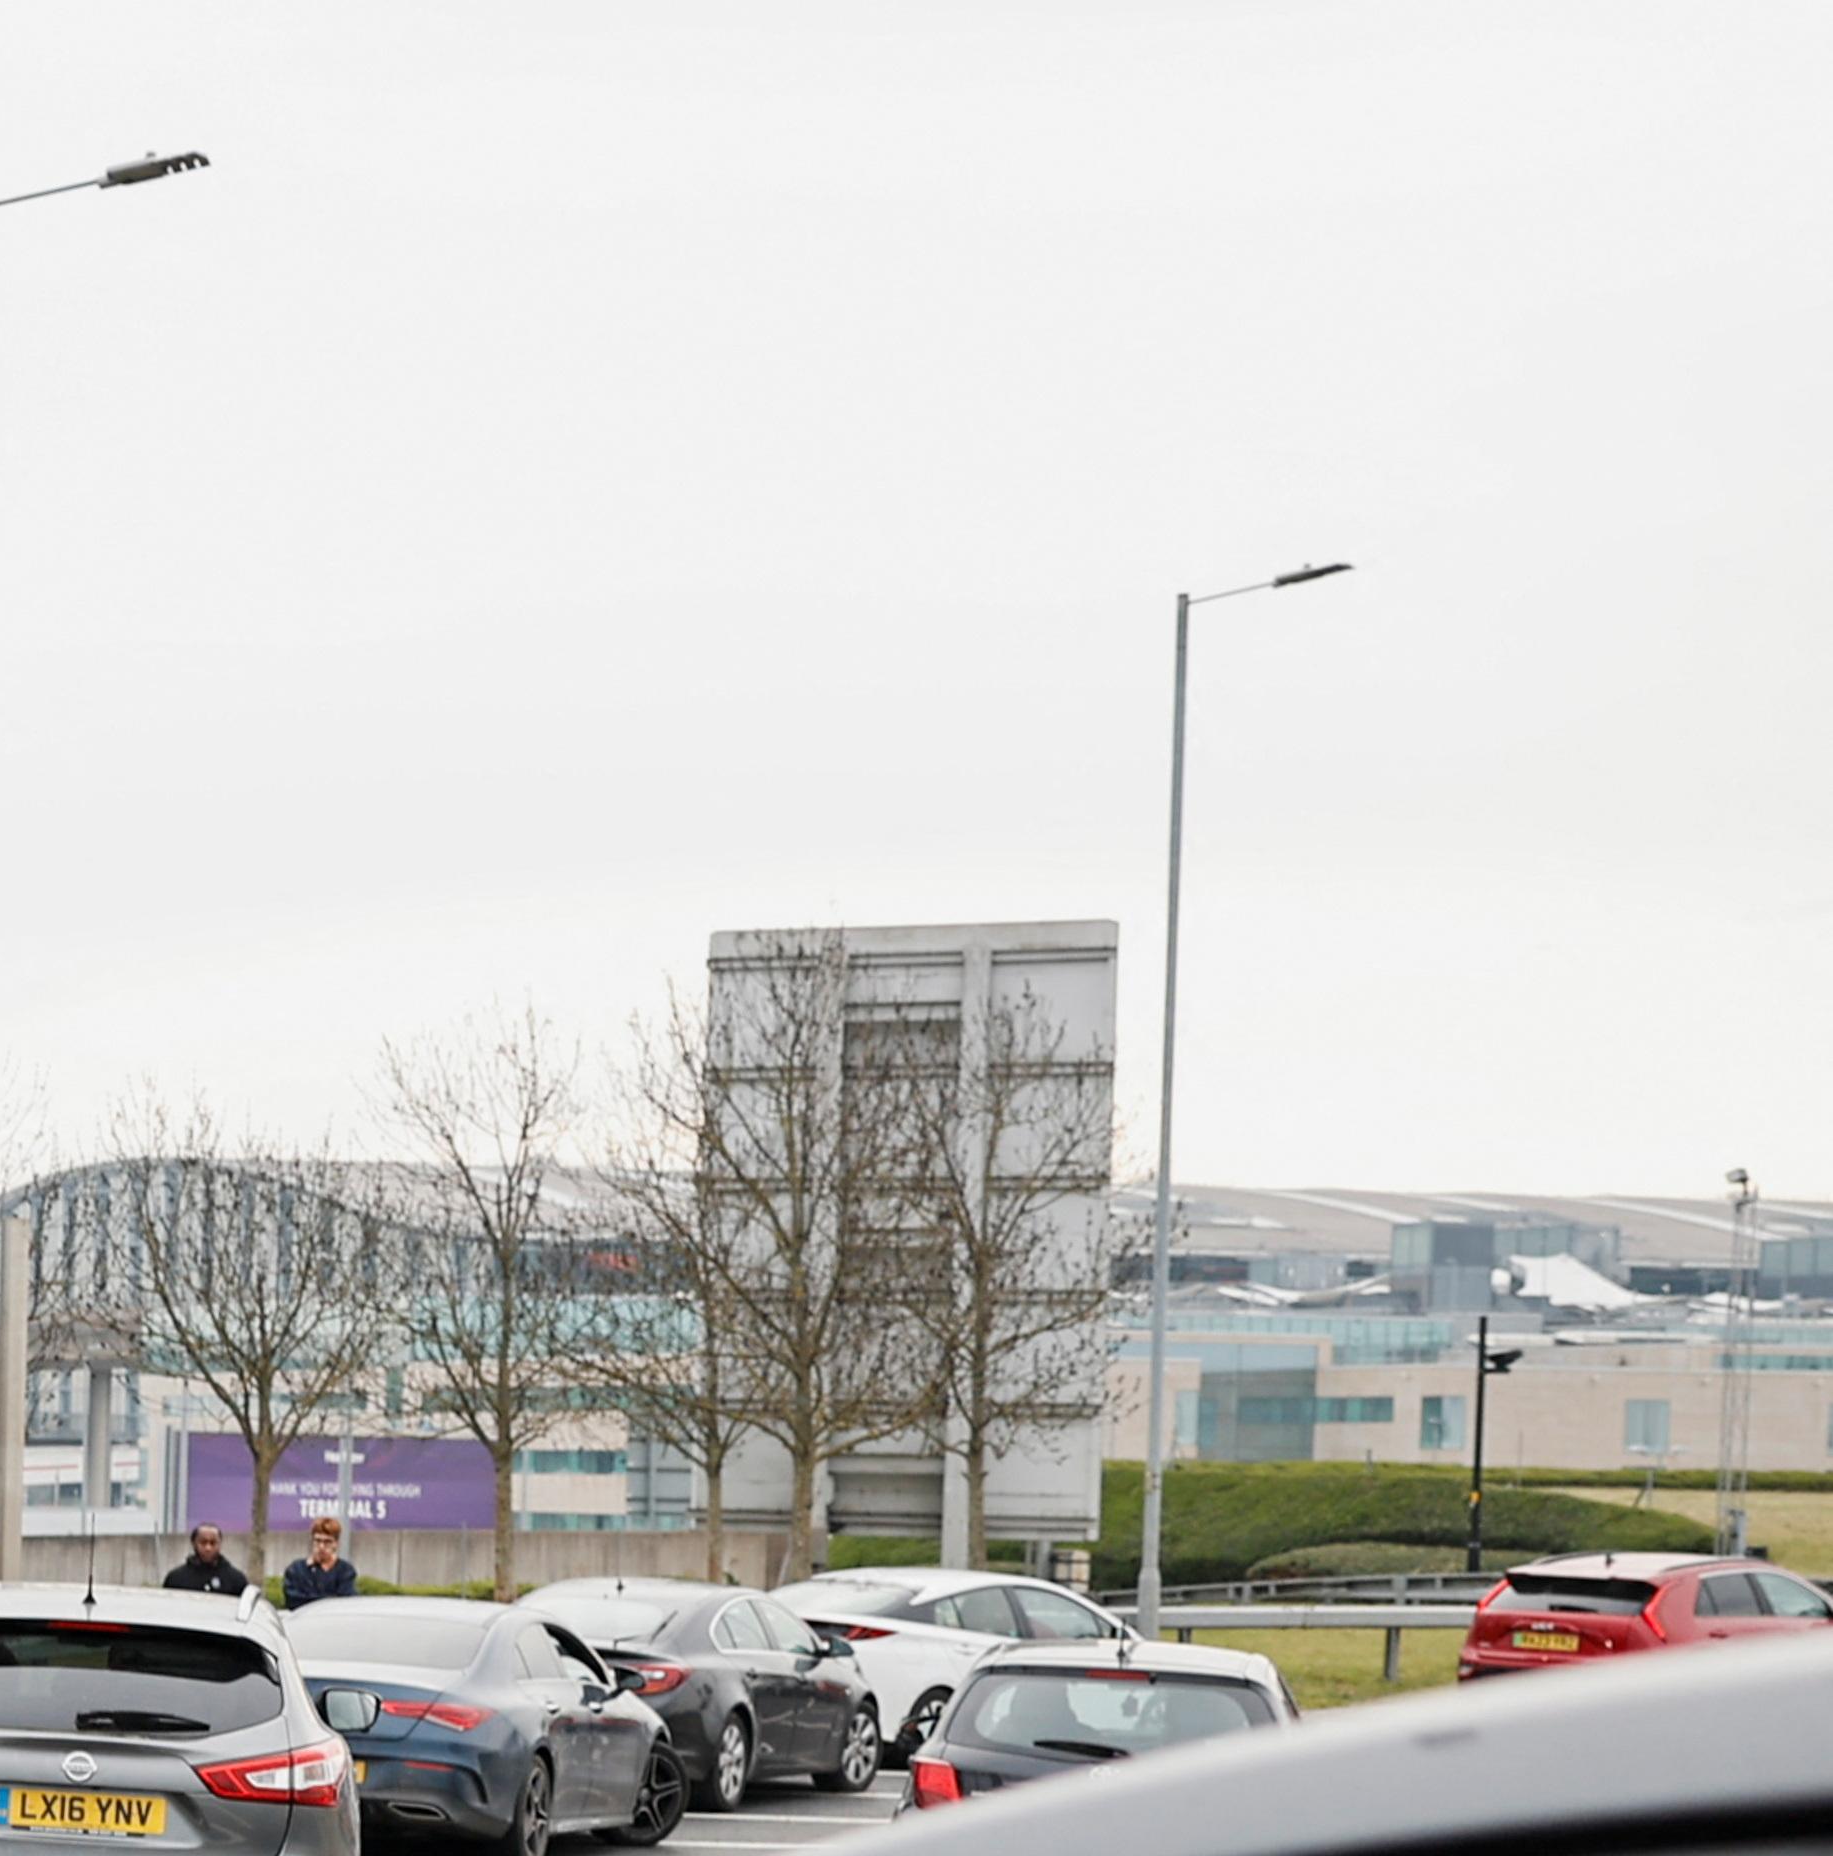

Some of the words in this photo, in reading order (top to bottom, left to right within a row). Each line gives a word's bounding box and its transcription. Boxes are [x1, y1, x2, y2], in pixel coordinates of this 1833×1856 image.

[270, 1482, 297, 1495] HANK
[19, 1792, 85, 1821] LX16
[96, 1795, 154, 1826] YNV
